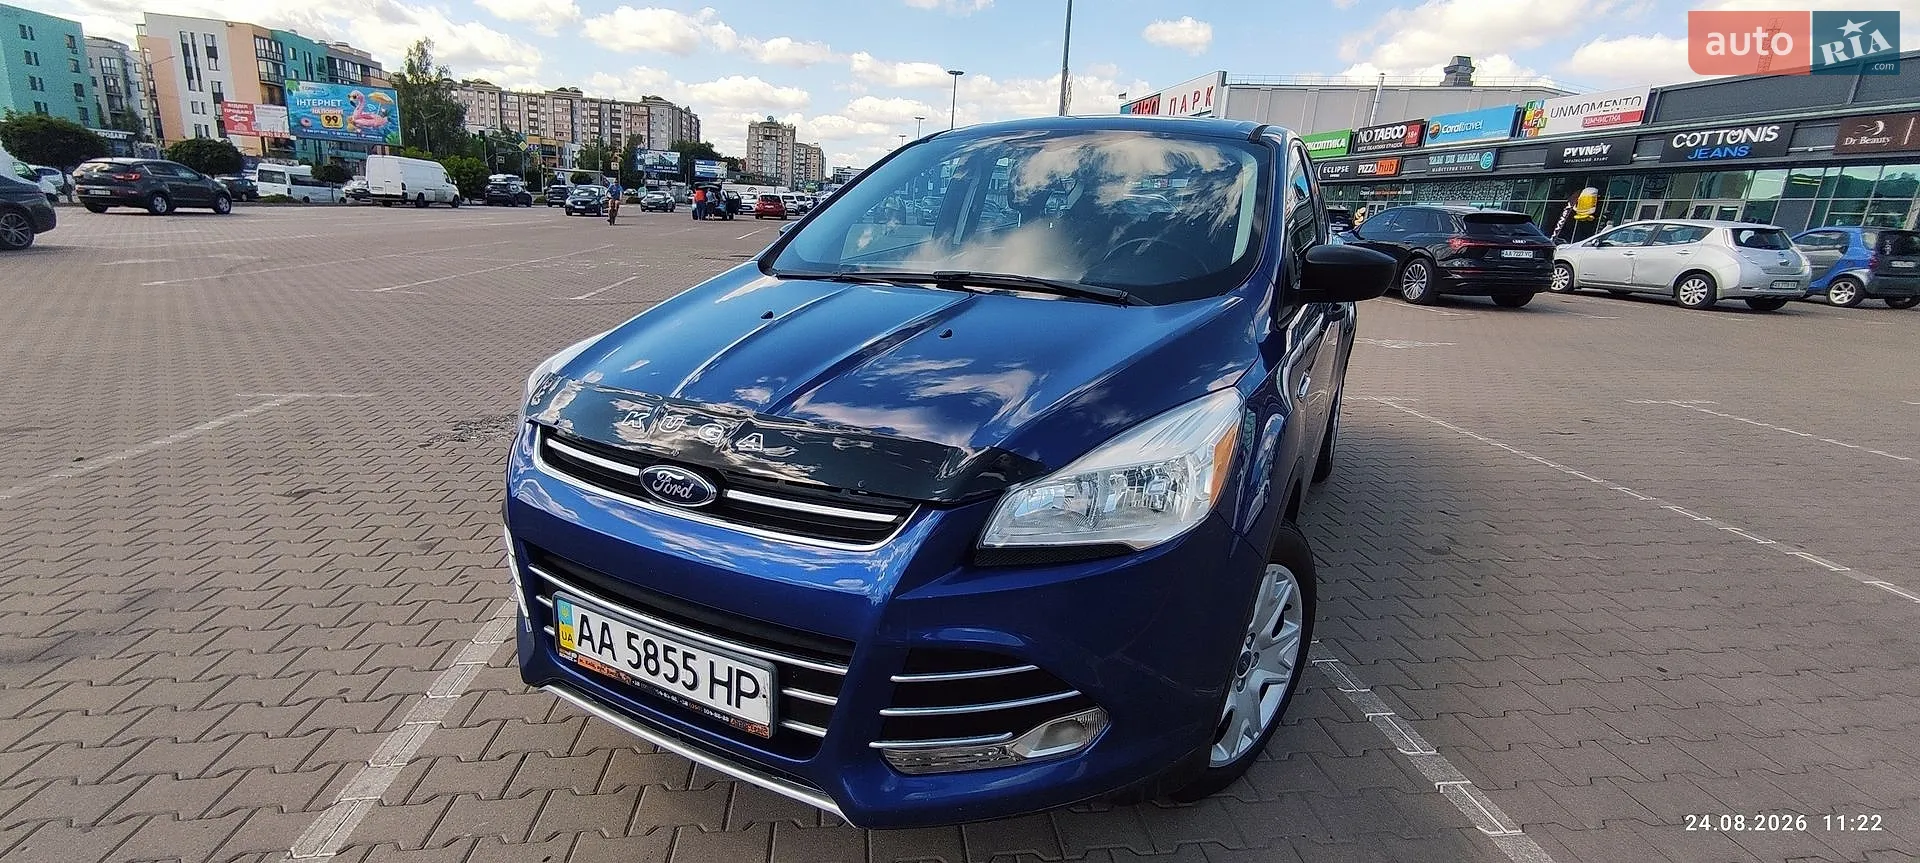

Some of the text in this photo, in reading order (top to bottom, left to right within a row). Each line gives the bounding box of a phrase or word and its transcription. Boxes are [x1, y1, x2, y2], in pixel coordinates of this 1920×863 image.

[296, 98, 343, 108] ІНТЕРНЕТ
[1168, 85, 1214, 116] ПАРК
[324, 114, 339, 125] 99
[1357, 130, 1374, 144] NO
[1374, 124, 1408, 141] TABOO
[1672, 125, 1780, 149] COTTONIS
[1842, 135, 1892, 146] Dr Beauty
[1687, 145, 1750, 160] JEANS
[1323, 165, 1350, 174] ECLIPSE
[1357, 163, 1376, 174] PIZZA
[621, 411, 764, 451] KUGA
[652, 470, 695, 500] Ford
[561, 632, 574, 645] UA
[577, 613, 617, 662] AA
[626, 631, 699, 691] 5855
[709, 660, 761, 709] HP
